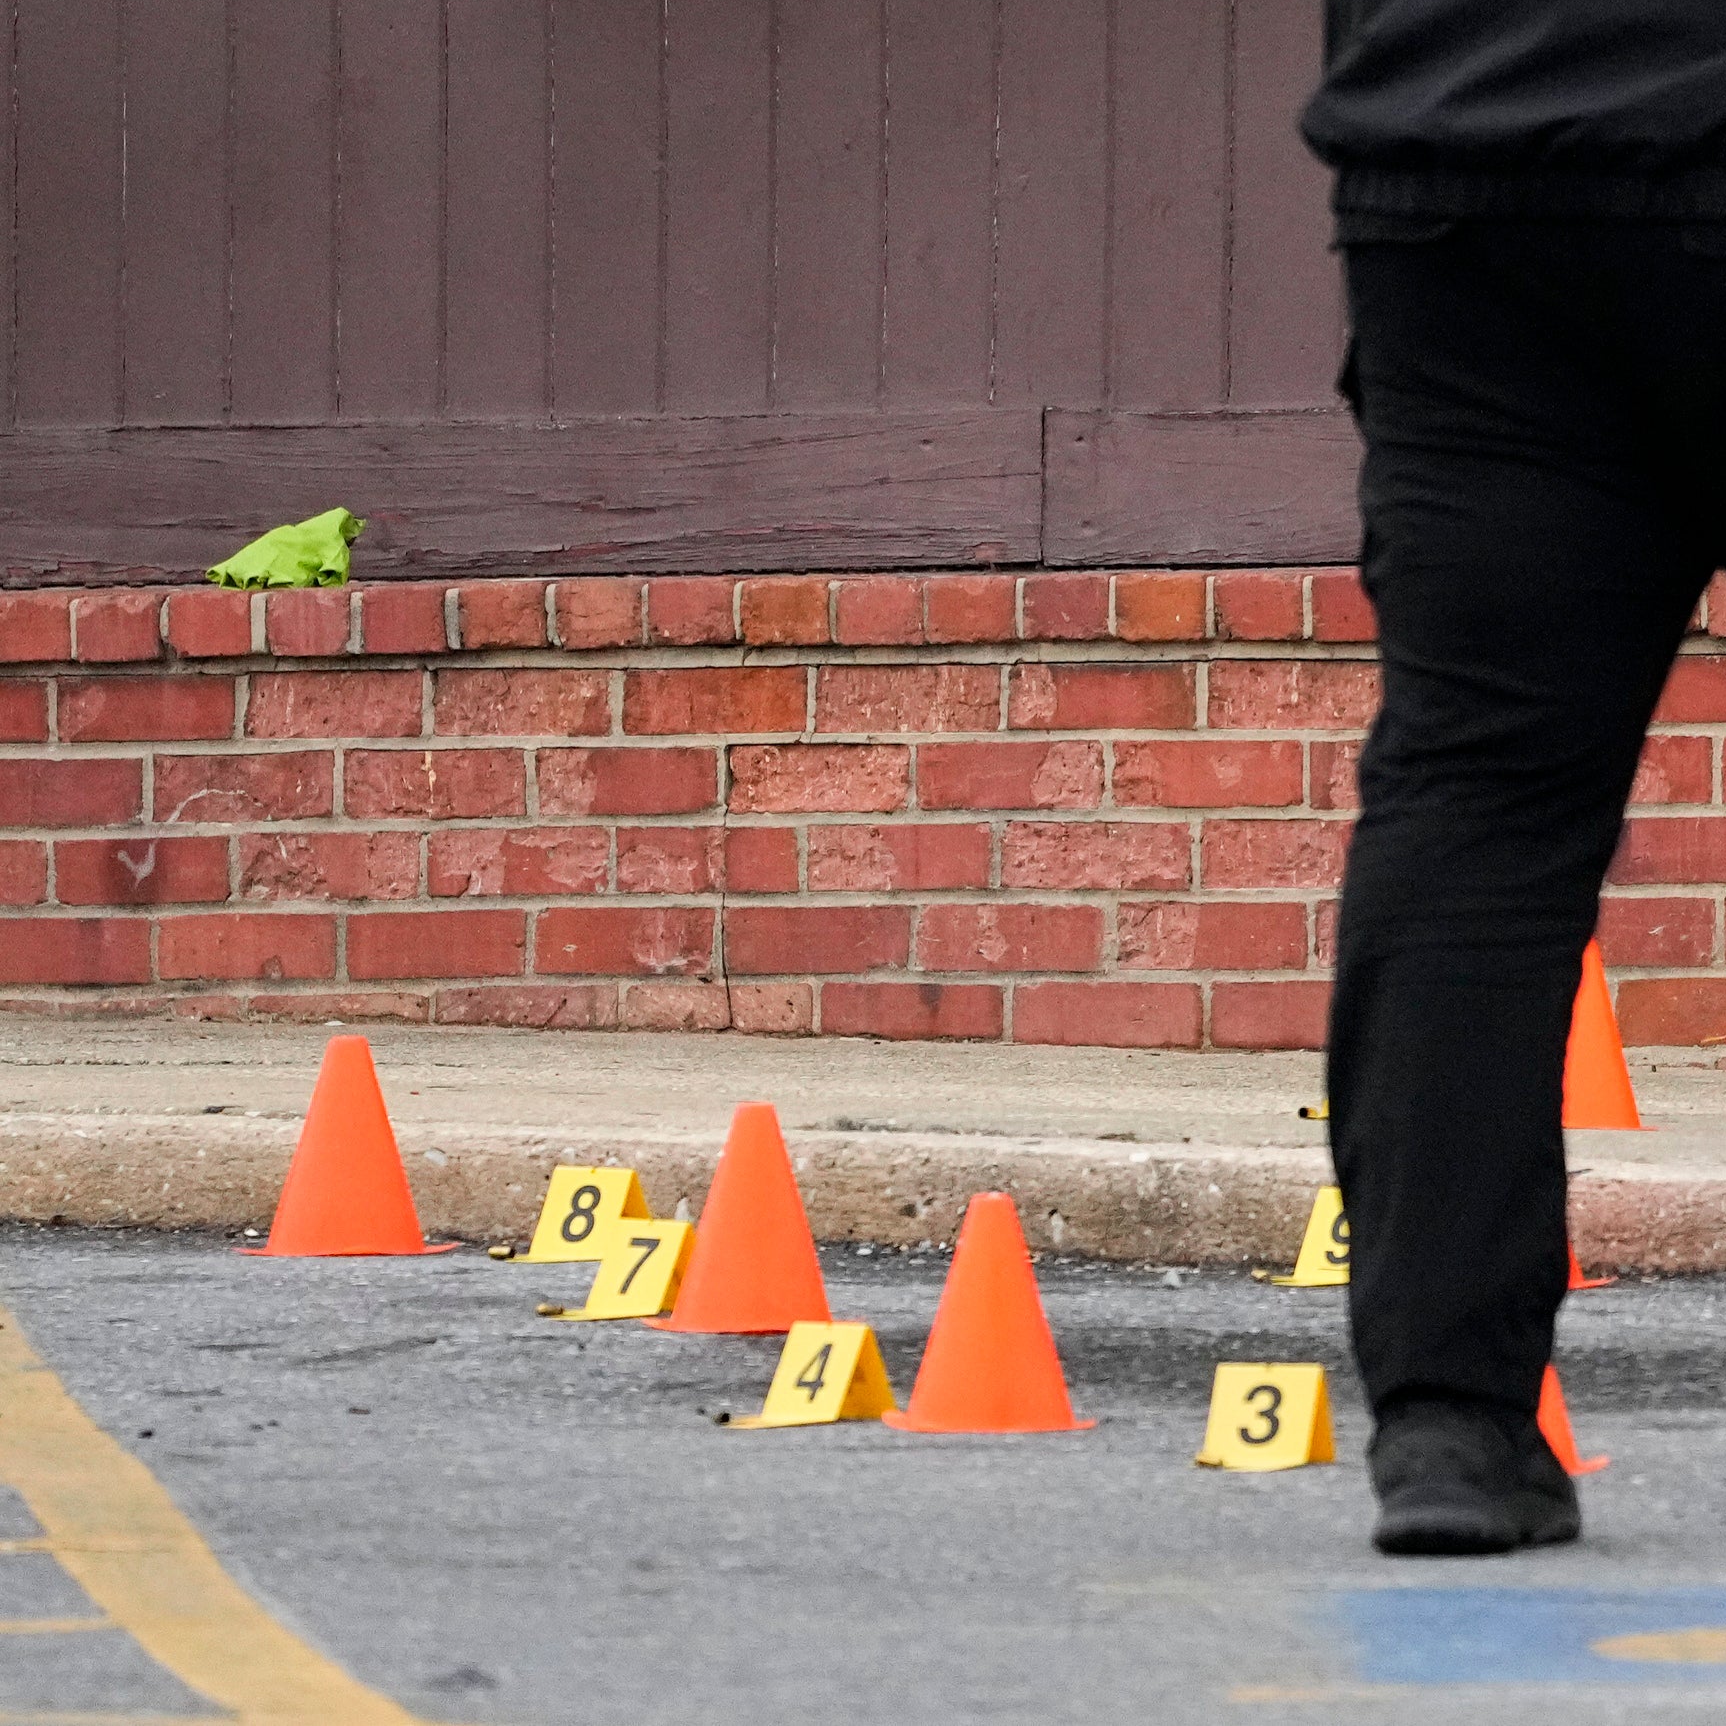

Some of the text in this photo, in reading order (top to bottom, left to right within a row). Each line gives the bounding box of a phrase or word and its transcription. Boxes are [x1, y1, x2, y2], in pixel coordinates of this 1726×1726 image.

[561, 1185, 601, 1242] 8
[619, 1237, 661, 1294] 7
[794, 1343, 833, 1402] 4
[1239, 1384, 1282, 1445] 3
